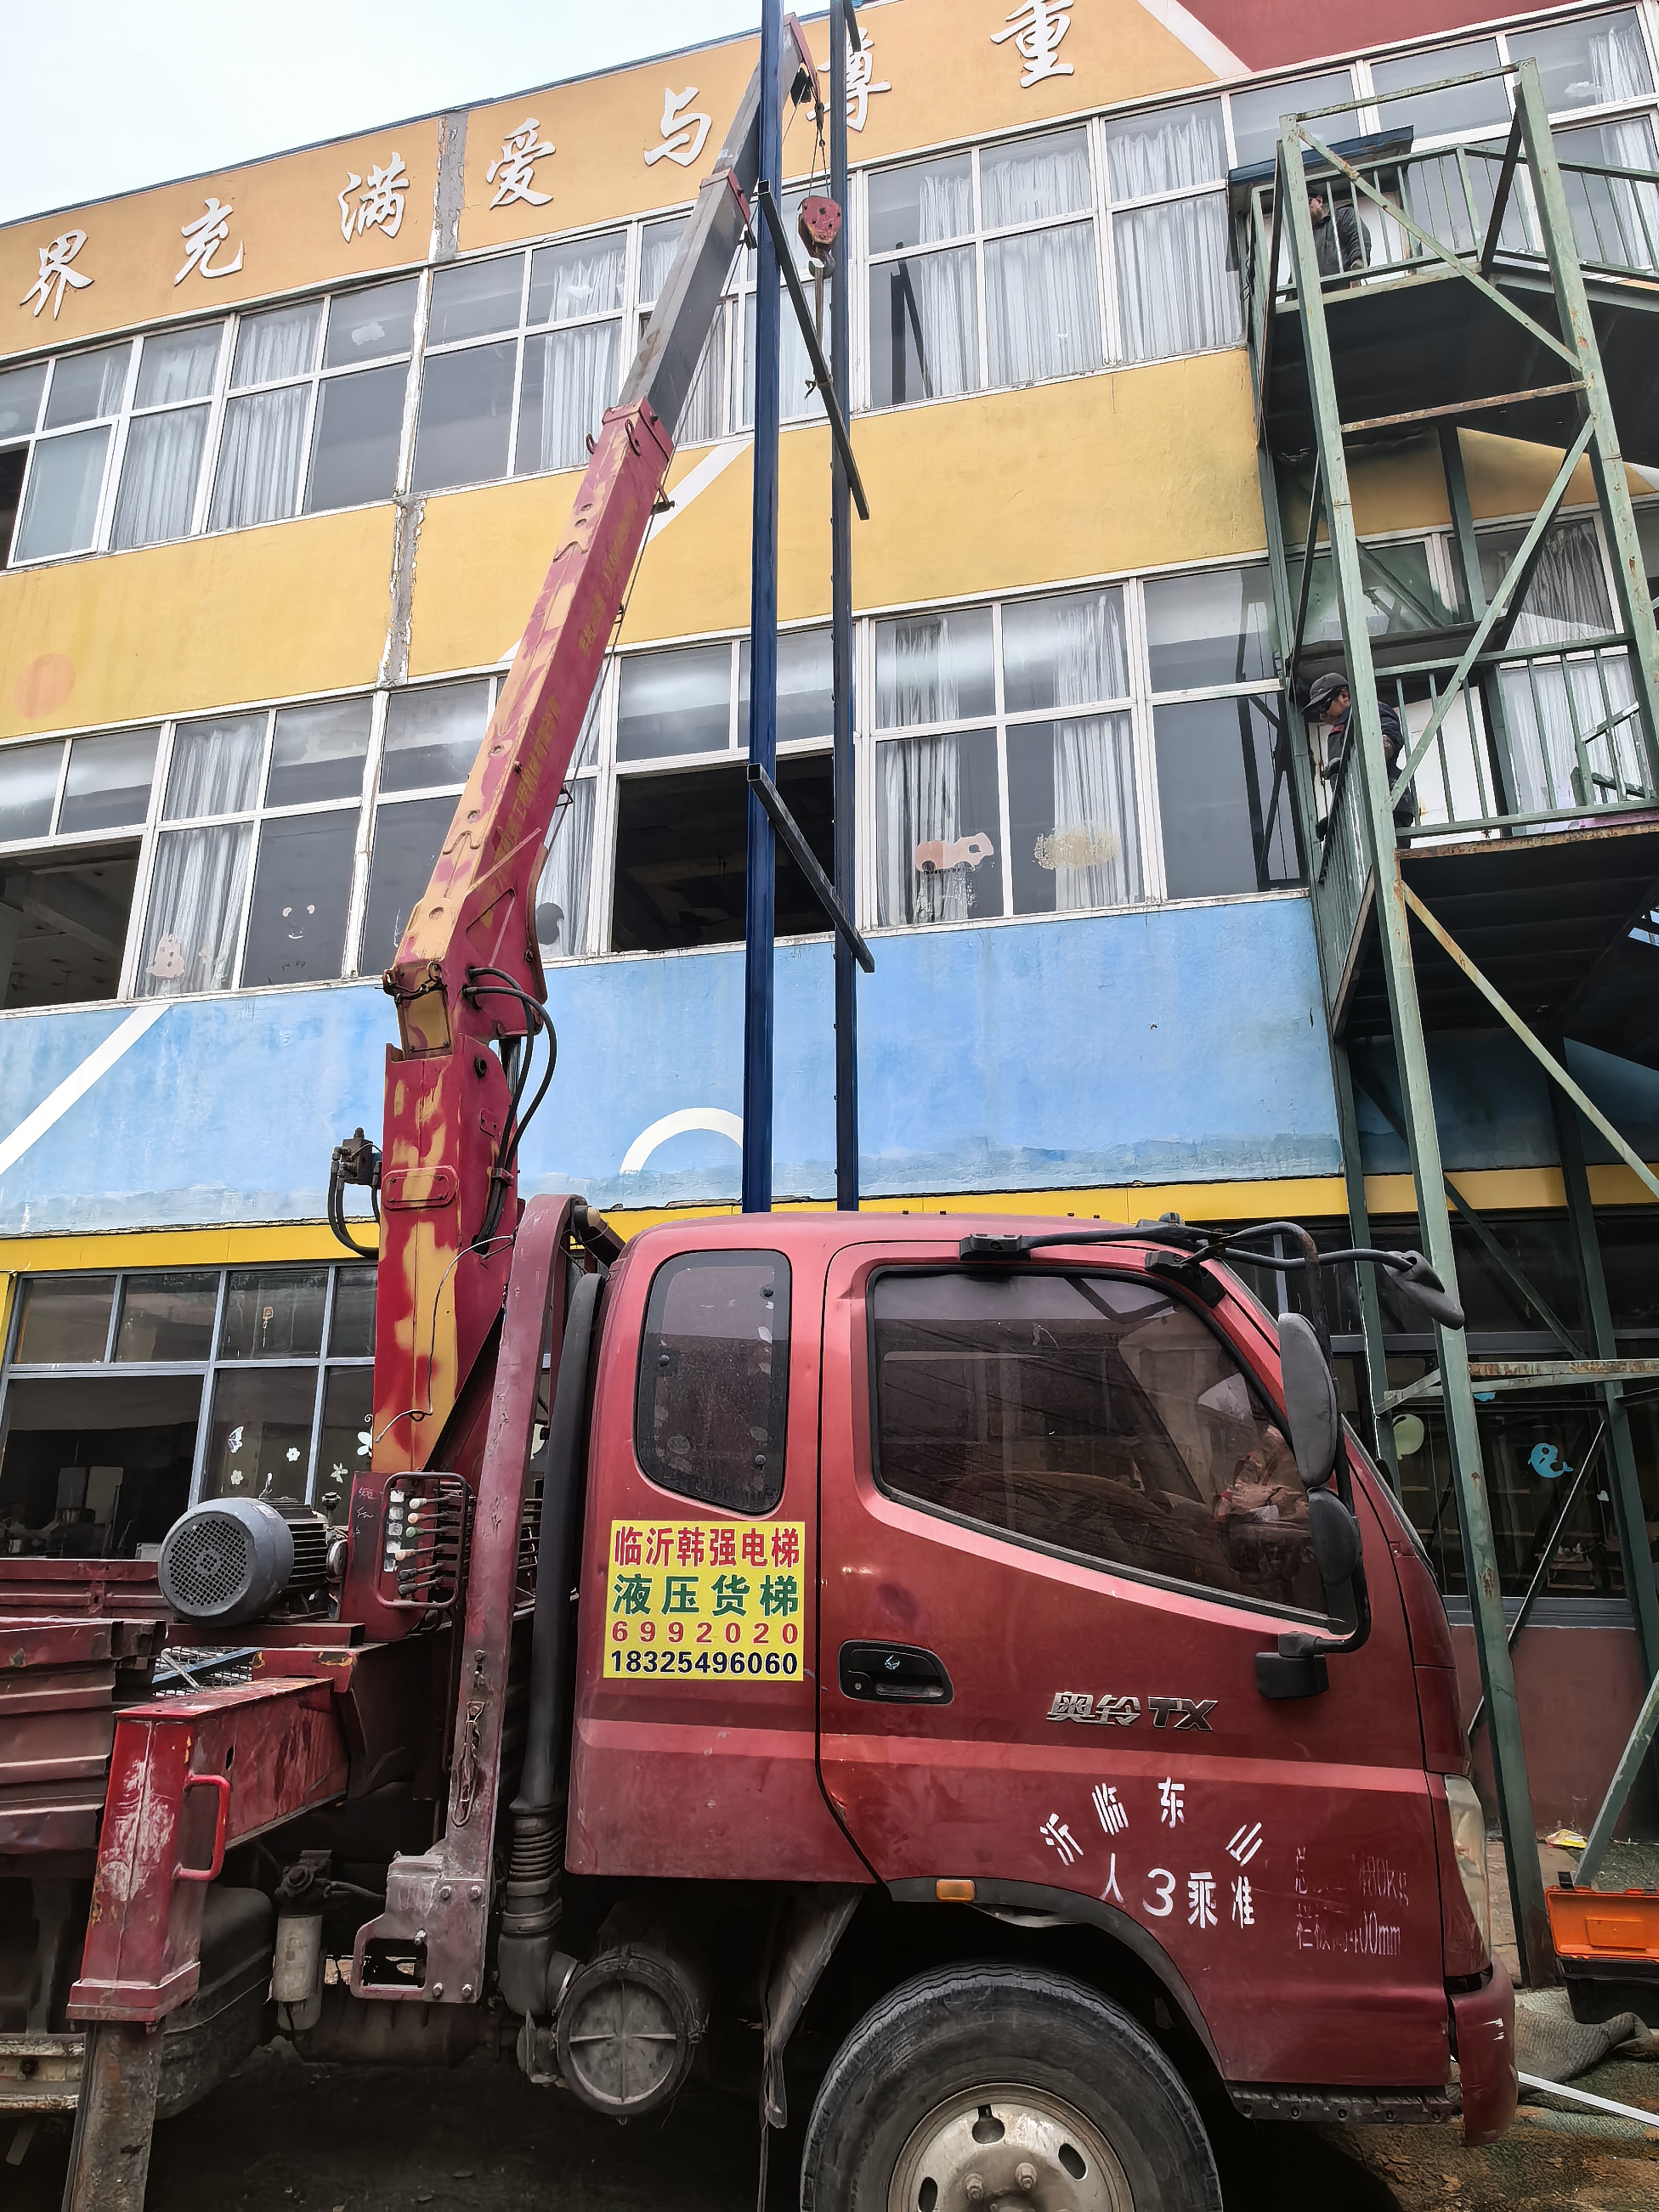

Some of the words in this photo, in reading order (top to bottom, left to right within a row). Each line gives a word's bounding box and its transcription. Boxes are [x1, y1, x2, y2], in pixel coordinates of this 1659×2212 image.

[614, 1526, 800, 1568] 临沂韩强电梯
[612, 1573, 799, 1617] 液压货梯
[611, 1620, 798, 1645] 6992020
[611, 1650, 798, 1674] 18325496060
[1046, 1691, 1141, 1726] 奥铃
[1147, 1696, 1219, 1732] TX
